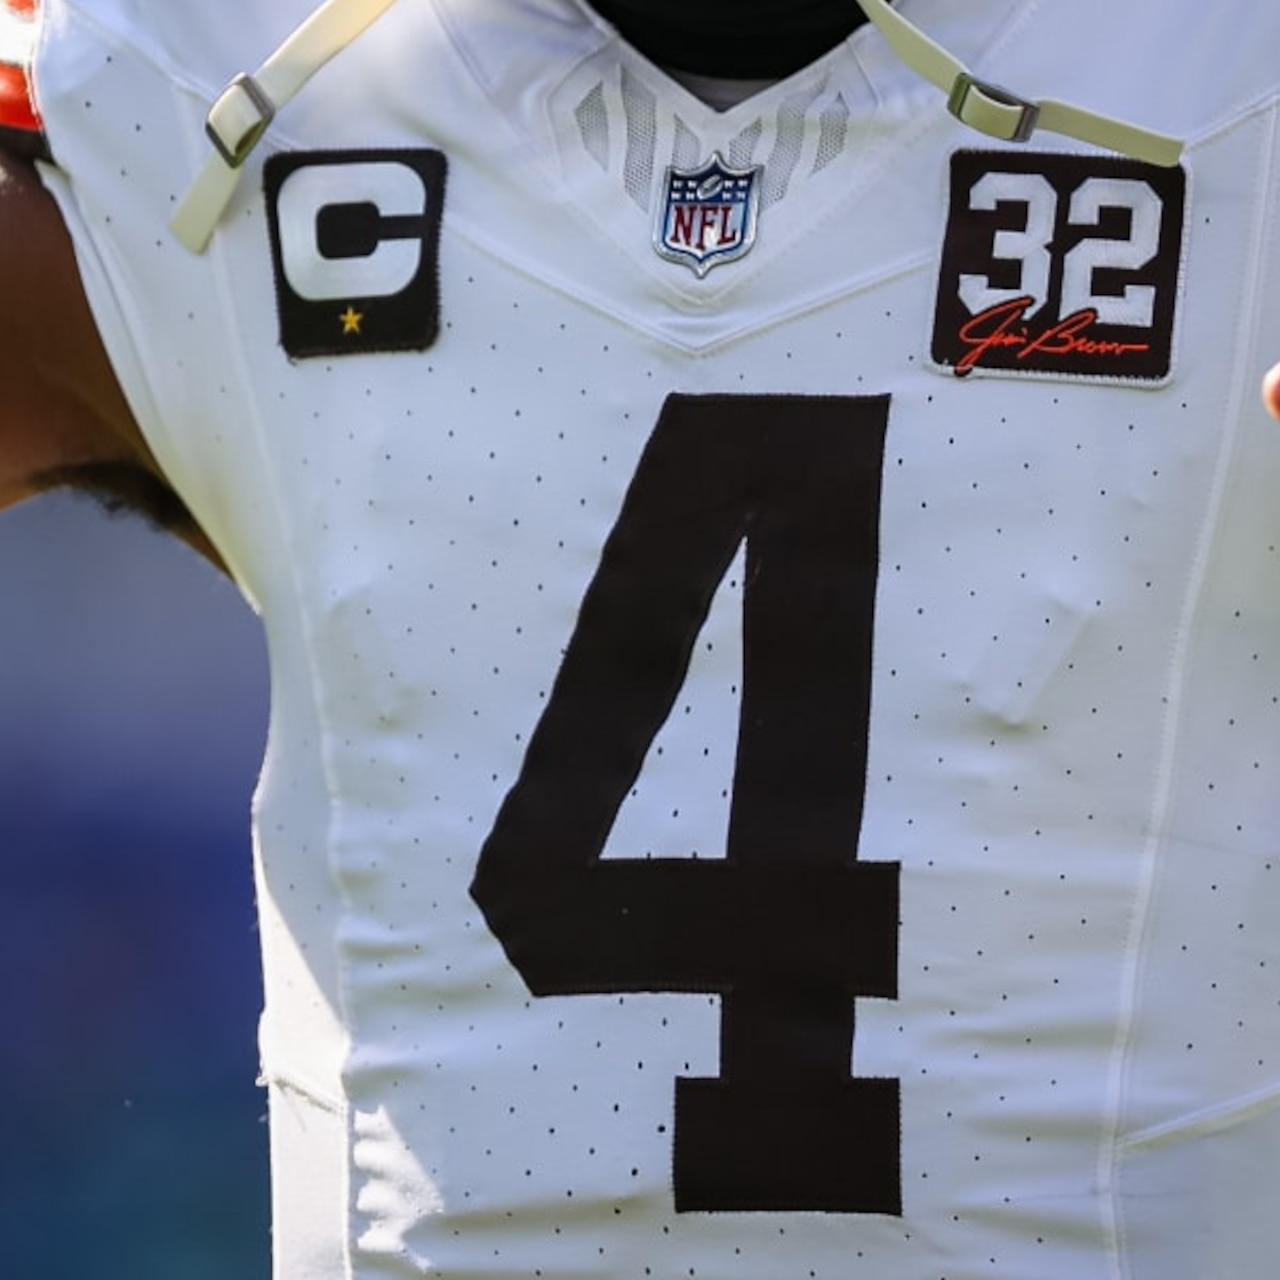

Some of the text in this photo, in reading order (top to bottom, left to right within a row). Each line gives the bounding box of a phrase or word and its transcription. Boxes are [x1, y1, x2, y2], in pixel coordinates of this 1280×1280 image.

[277, 161, 426, 301] C
[670, 204, 737, 251] NFL
[957, 172, 1163, 327] 32
[469, 393, 903, 1216] 4
